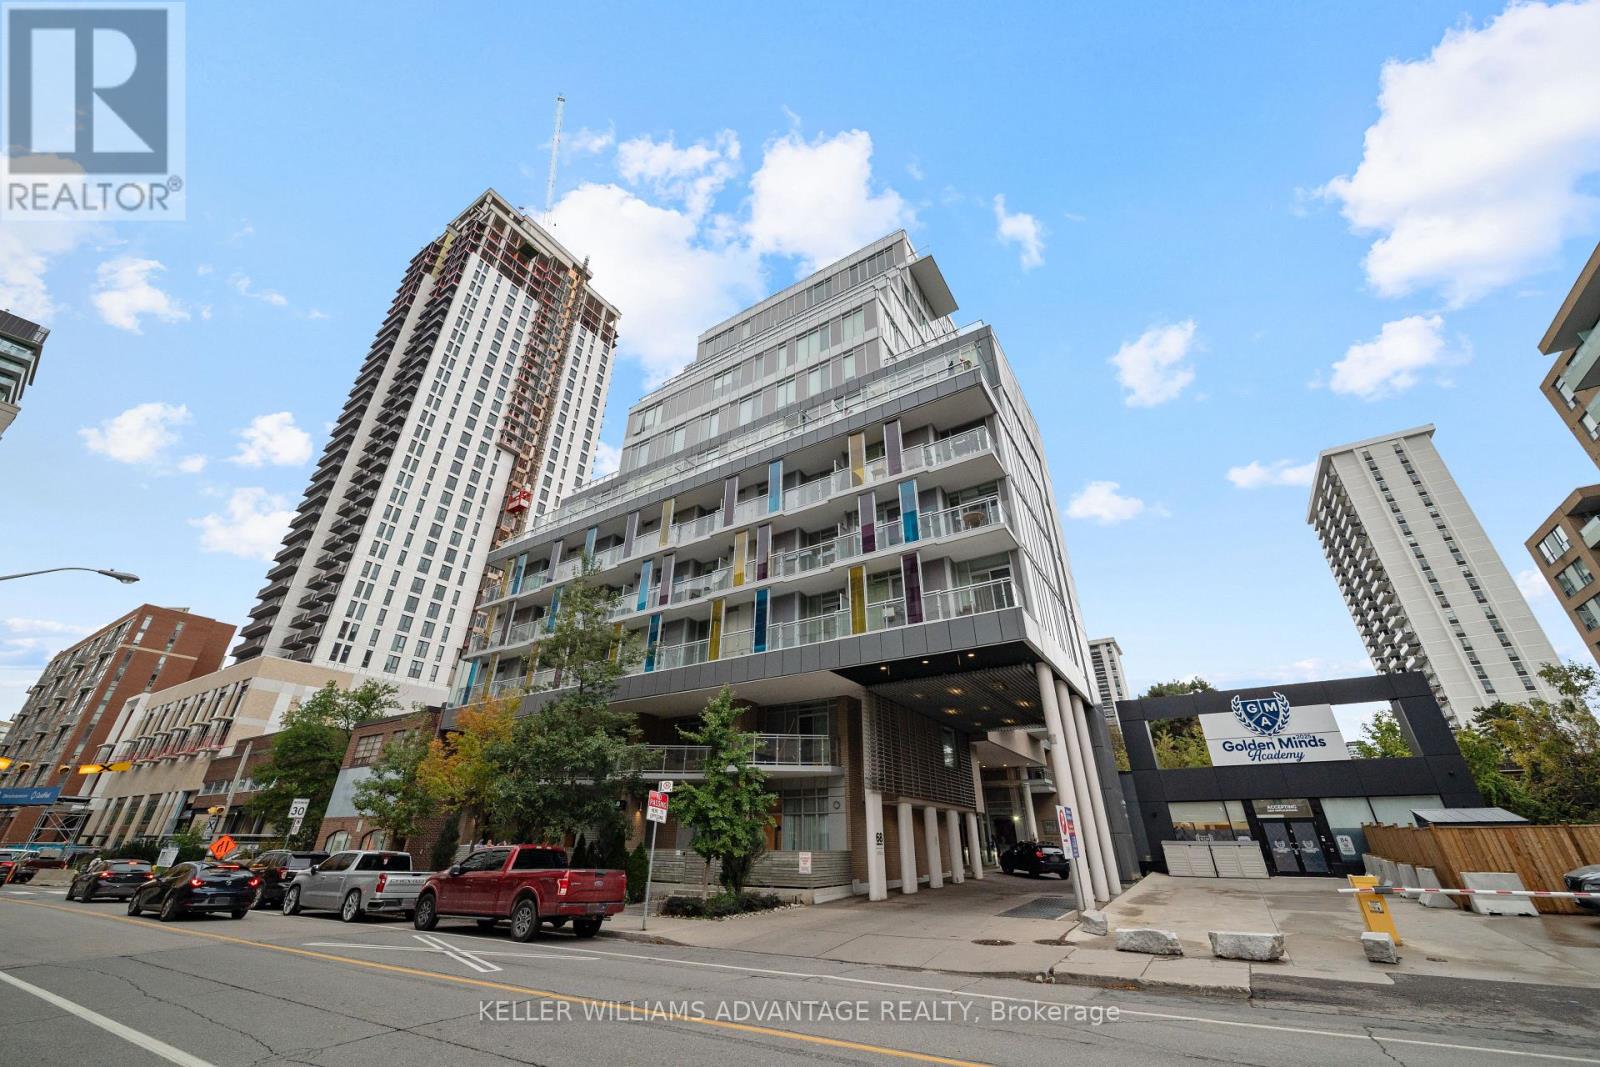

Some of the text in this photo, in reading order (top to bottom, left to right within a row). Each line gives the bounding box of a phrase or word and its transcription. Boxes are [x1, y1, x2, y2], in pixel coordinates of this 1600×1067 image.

[1222, 735, 1327, 752] Golden Minds
[1247, 750, 1305, 762] Academy
[291, 806, 305, 816] 30
